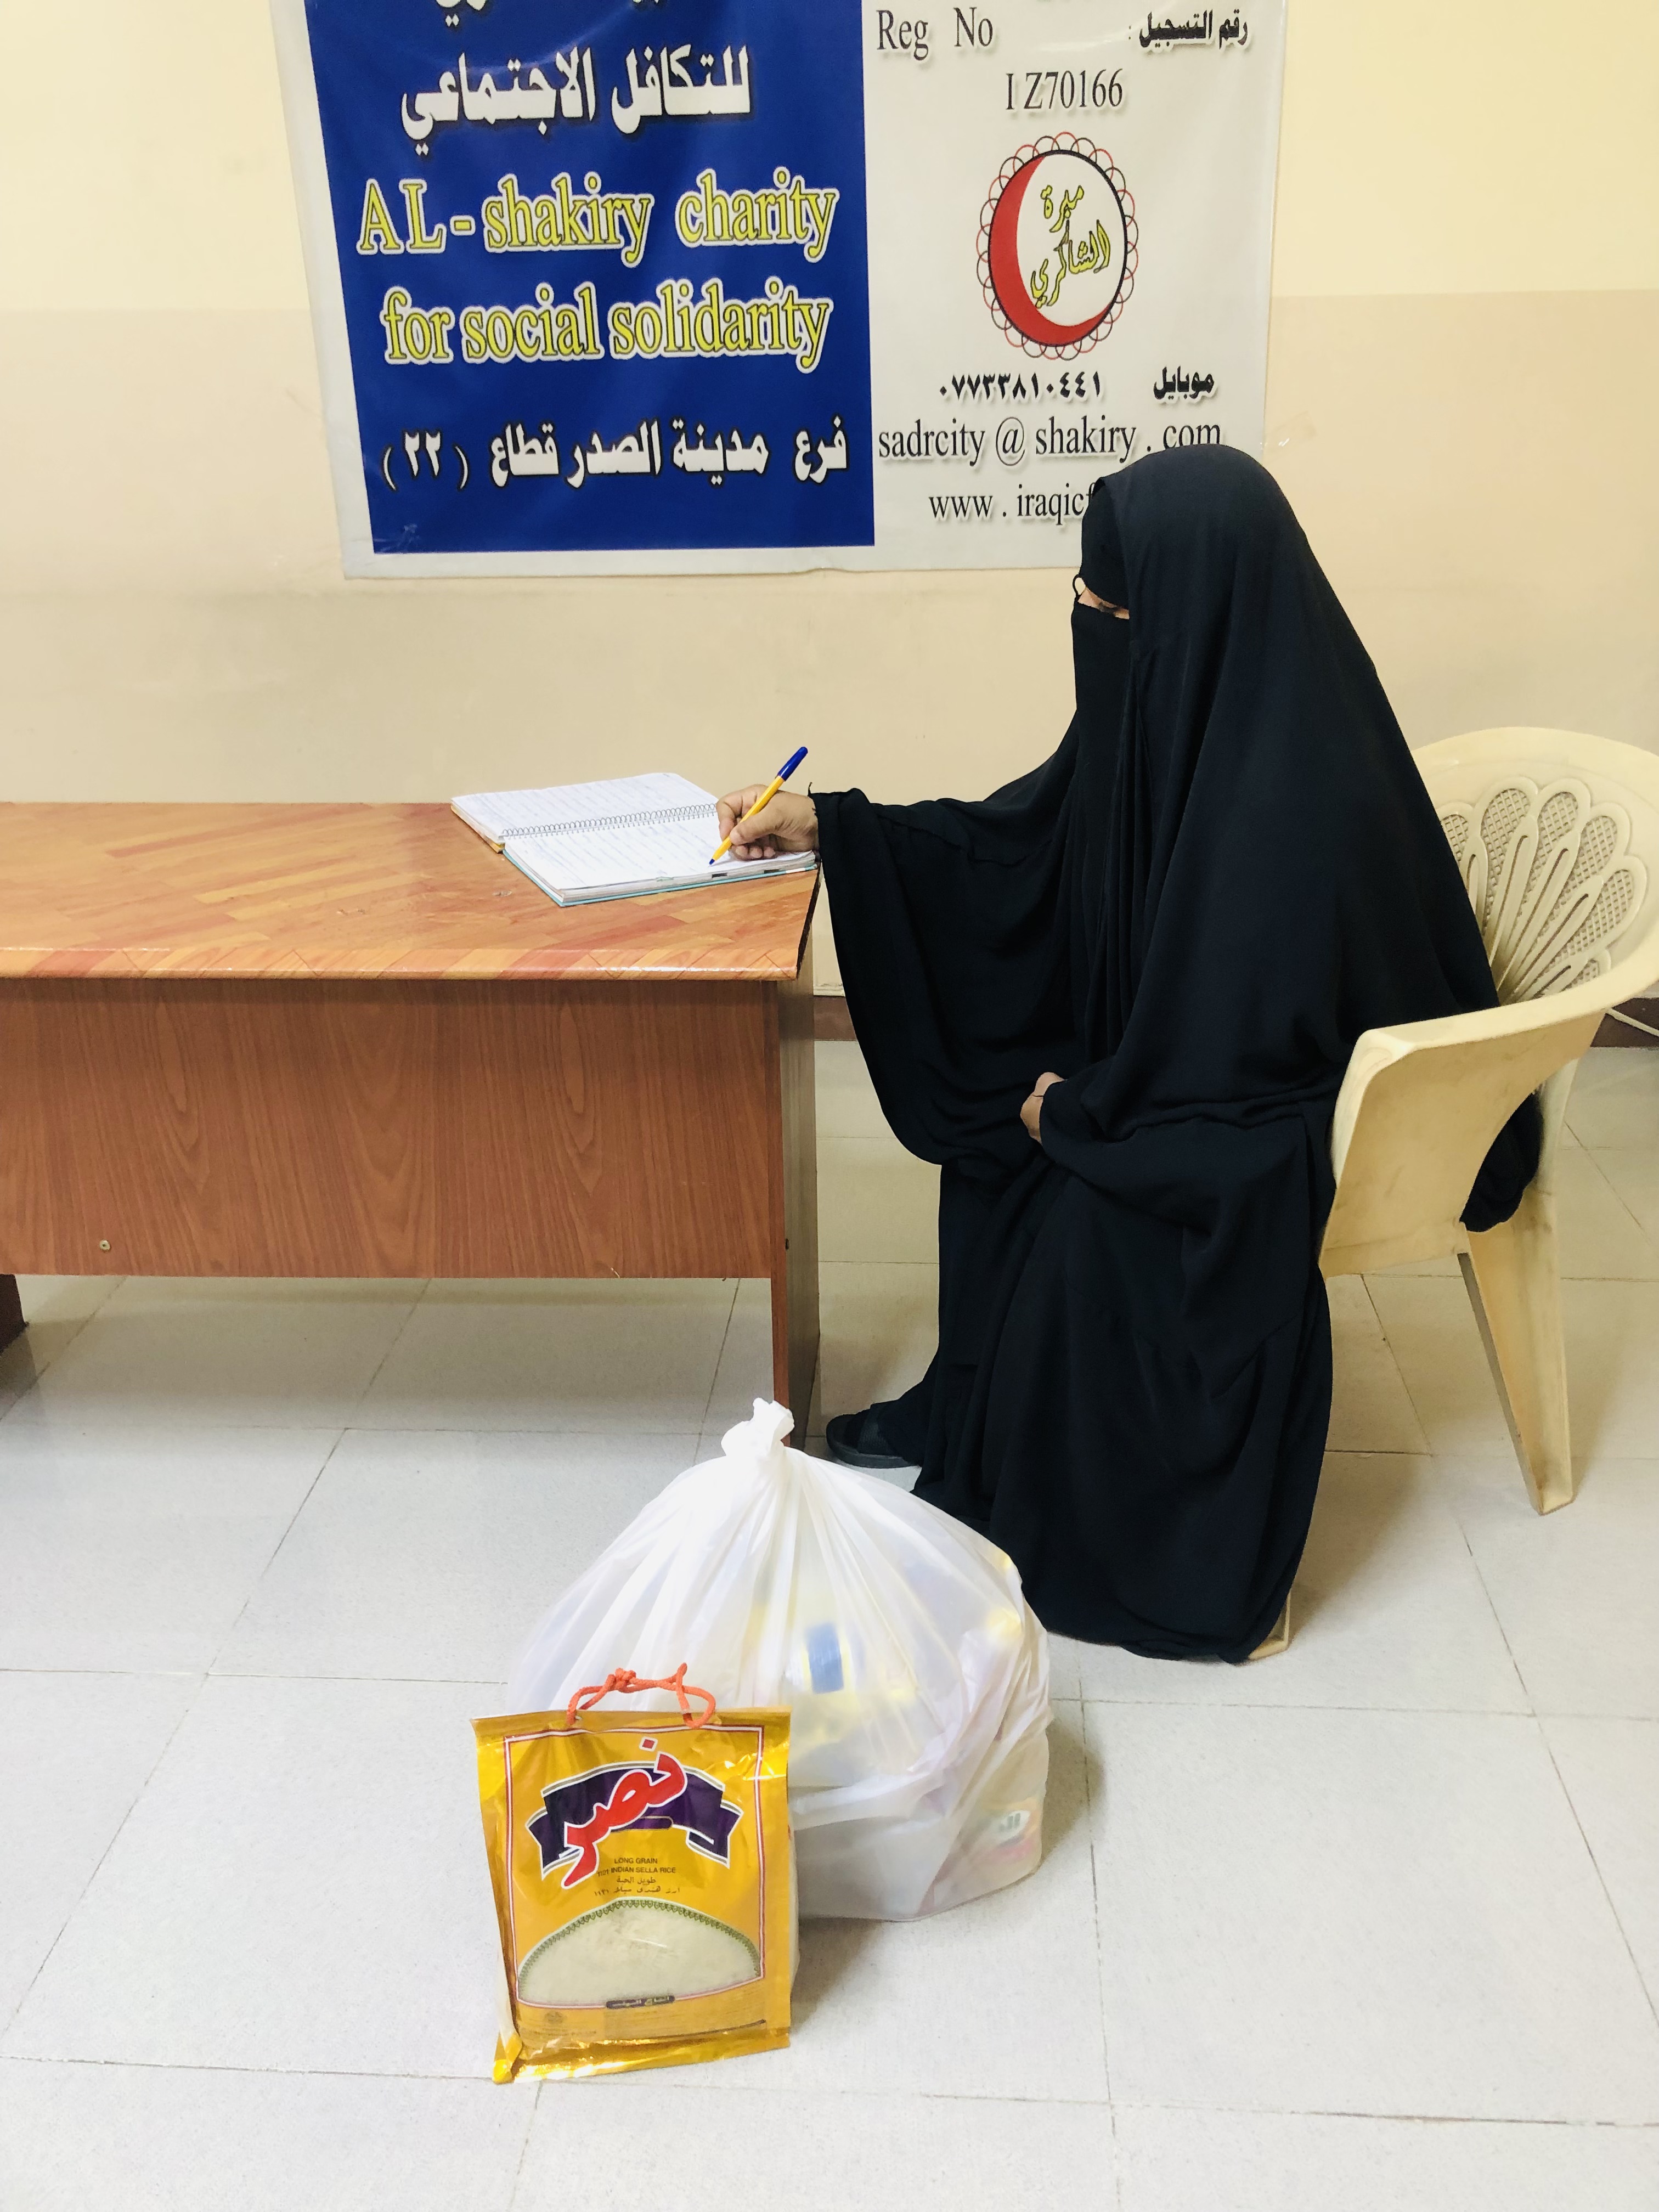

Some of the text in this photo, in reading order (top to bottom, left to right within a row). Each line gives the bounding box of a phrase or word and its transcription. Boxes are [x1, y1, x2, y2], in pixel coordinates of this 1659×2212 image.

[877, 7, 994, 61] Reg No
[1218, 9, 1248, 49] رقم
[400, 43, 751, 156] للتكافل الاجتماعي
[674, 166, 840, 262] charity
[380, 276, 834, 373] for social solidarity
[1153, 366, 1215, 403] موبايل
[490, 423, 560, 487] قطاع
[567, 420, 661, 488] الصدر
[672, 419, 769, 486] مدينة
[794, 416, 847, 483] فرع
[878, 418, 985, 467] sadrcity
[1035, 415, 1137, 464] shakiry
[561, 1736, 687, 1889] نصر
